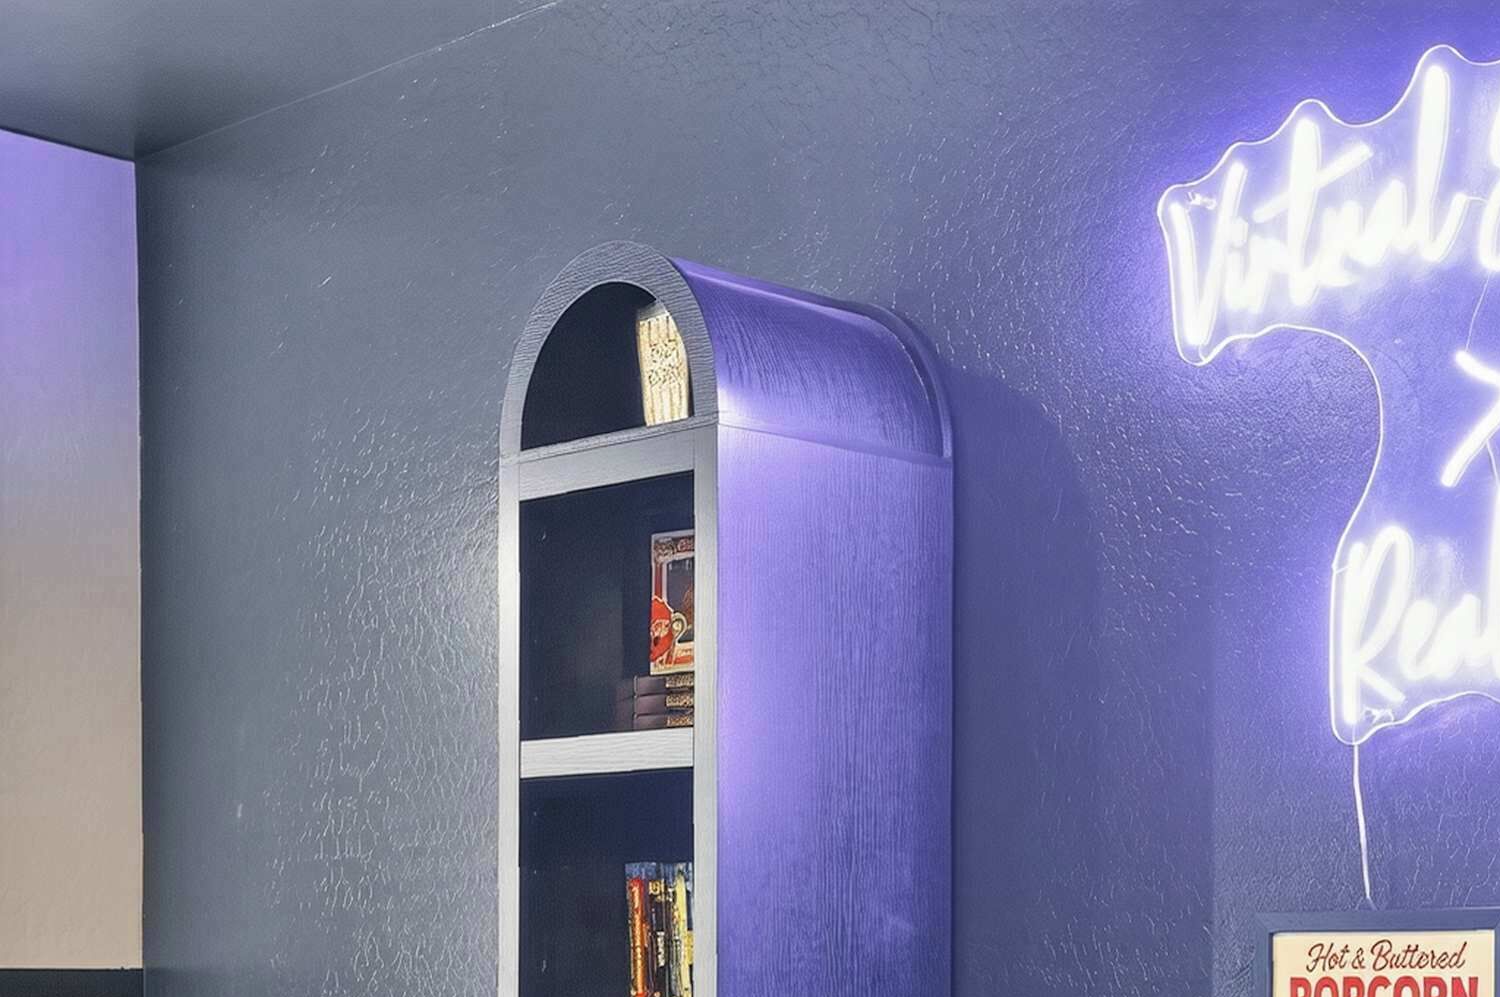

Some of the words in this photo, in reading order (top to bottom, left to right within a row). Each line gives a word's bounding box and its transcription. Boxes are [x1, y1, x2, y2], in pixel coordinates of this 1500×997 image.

[1169, 64, 1466, 346] Virtual
[1306, 943, 1349, 973] Hot
[1352, 947, 1366, 970] &
[1370, 939, 1468, 972] Buttered
